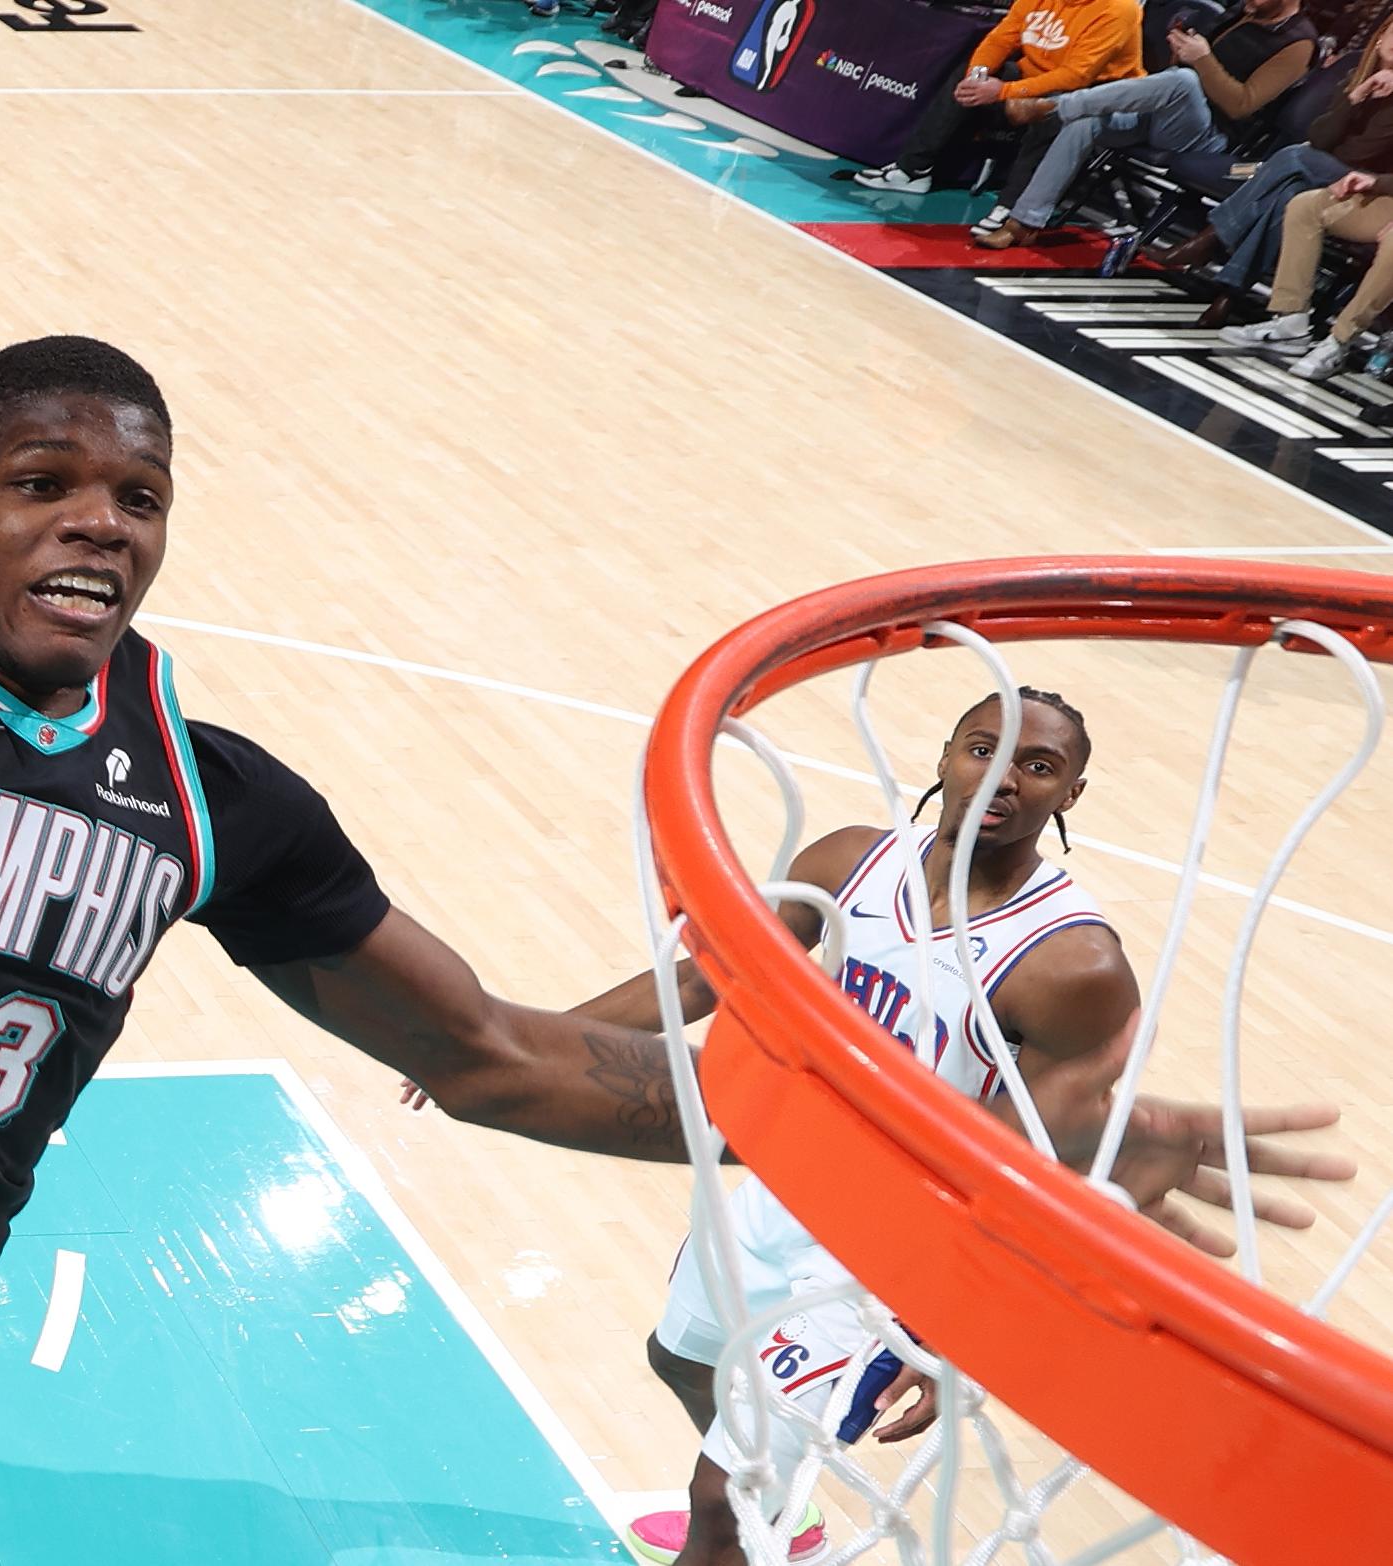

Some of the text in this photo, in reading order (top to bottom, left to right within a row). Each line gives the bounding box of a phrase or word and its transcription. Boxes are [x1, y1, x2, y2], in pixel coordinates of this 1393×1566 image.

[835, 58, 919, 100] NBC peacock
[95, 782, 172, 819] Robinhood
[759, 1327, 810, 1379] 76
